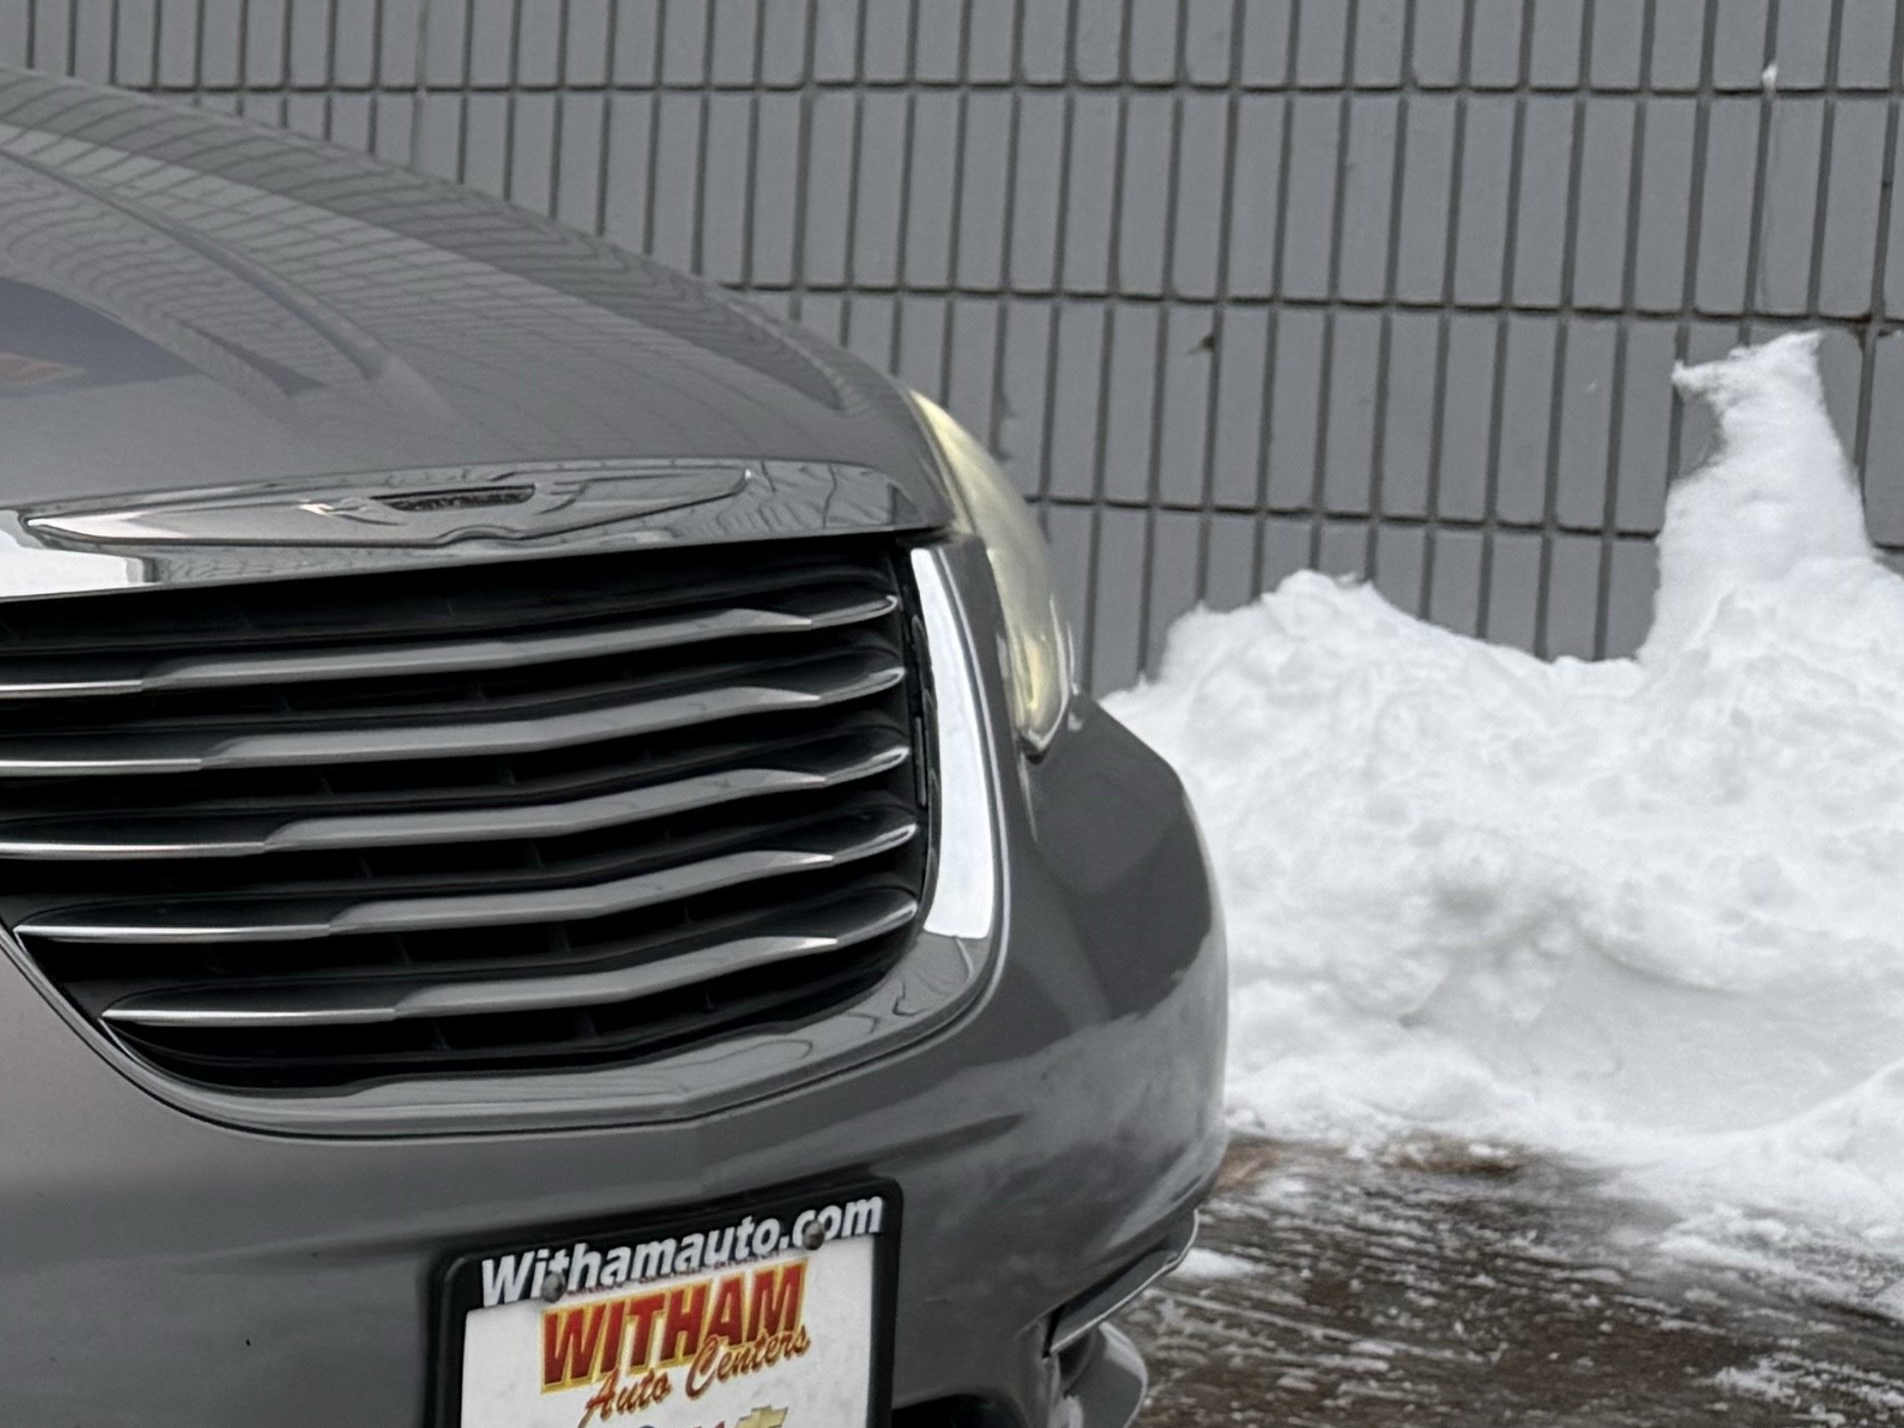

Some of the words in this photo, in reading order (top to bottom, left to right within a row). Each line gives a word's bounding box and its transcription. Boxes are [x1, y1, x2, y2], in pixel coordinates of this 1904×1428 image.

[481, 1195, 883, 1308] Withamauto.com
[540, 1259, 811, 1394] WITHAM
[685, 1323, 811, 1401] Centers
